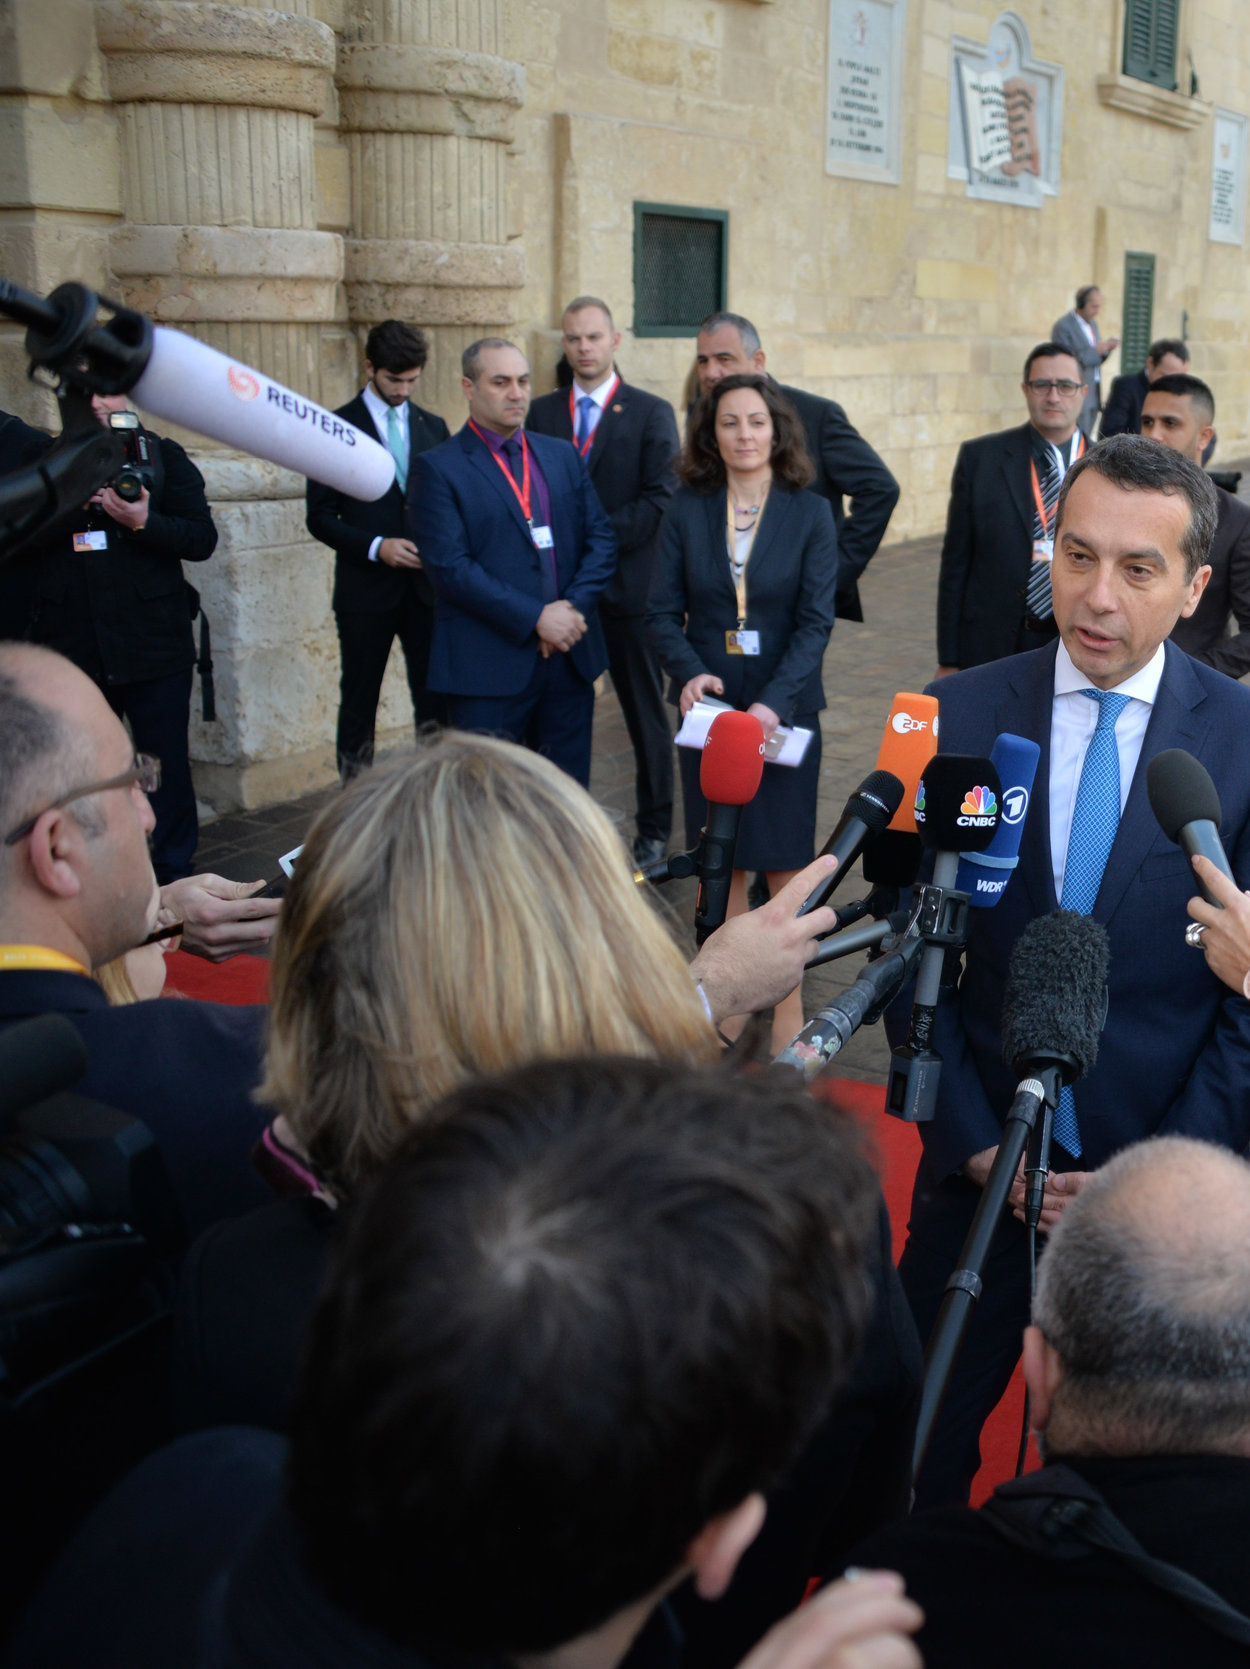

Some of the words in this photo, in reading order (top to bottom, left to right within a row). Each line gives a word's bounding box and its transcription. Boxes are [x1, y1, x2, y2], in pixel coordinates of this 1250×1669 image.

[267, 386, 356, 447] REUTERS
[902, 717, 929, 732] ZDF
[956, 816, 997, 827] CNBC
[976, 879, 1004, 893] WDR
